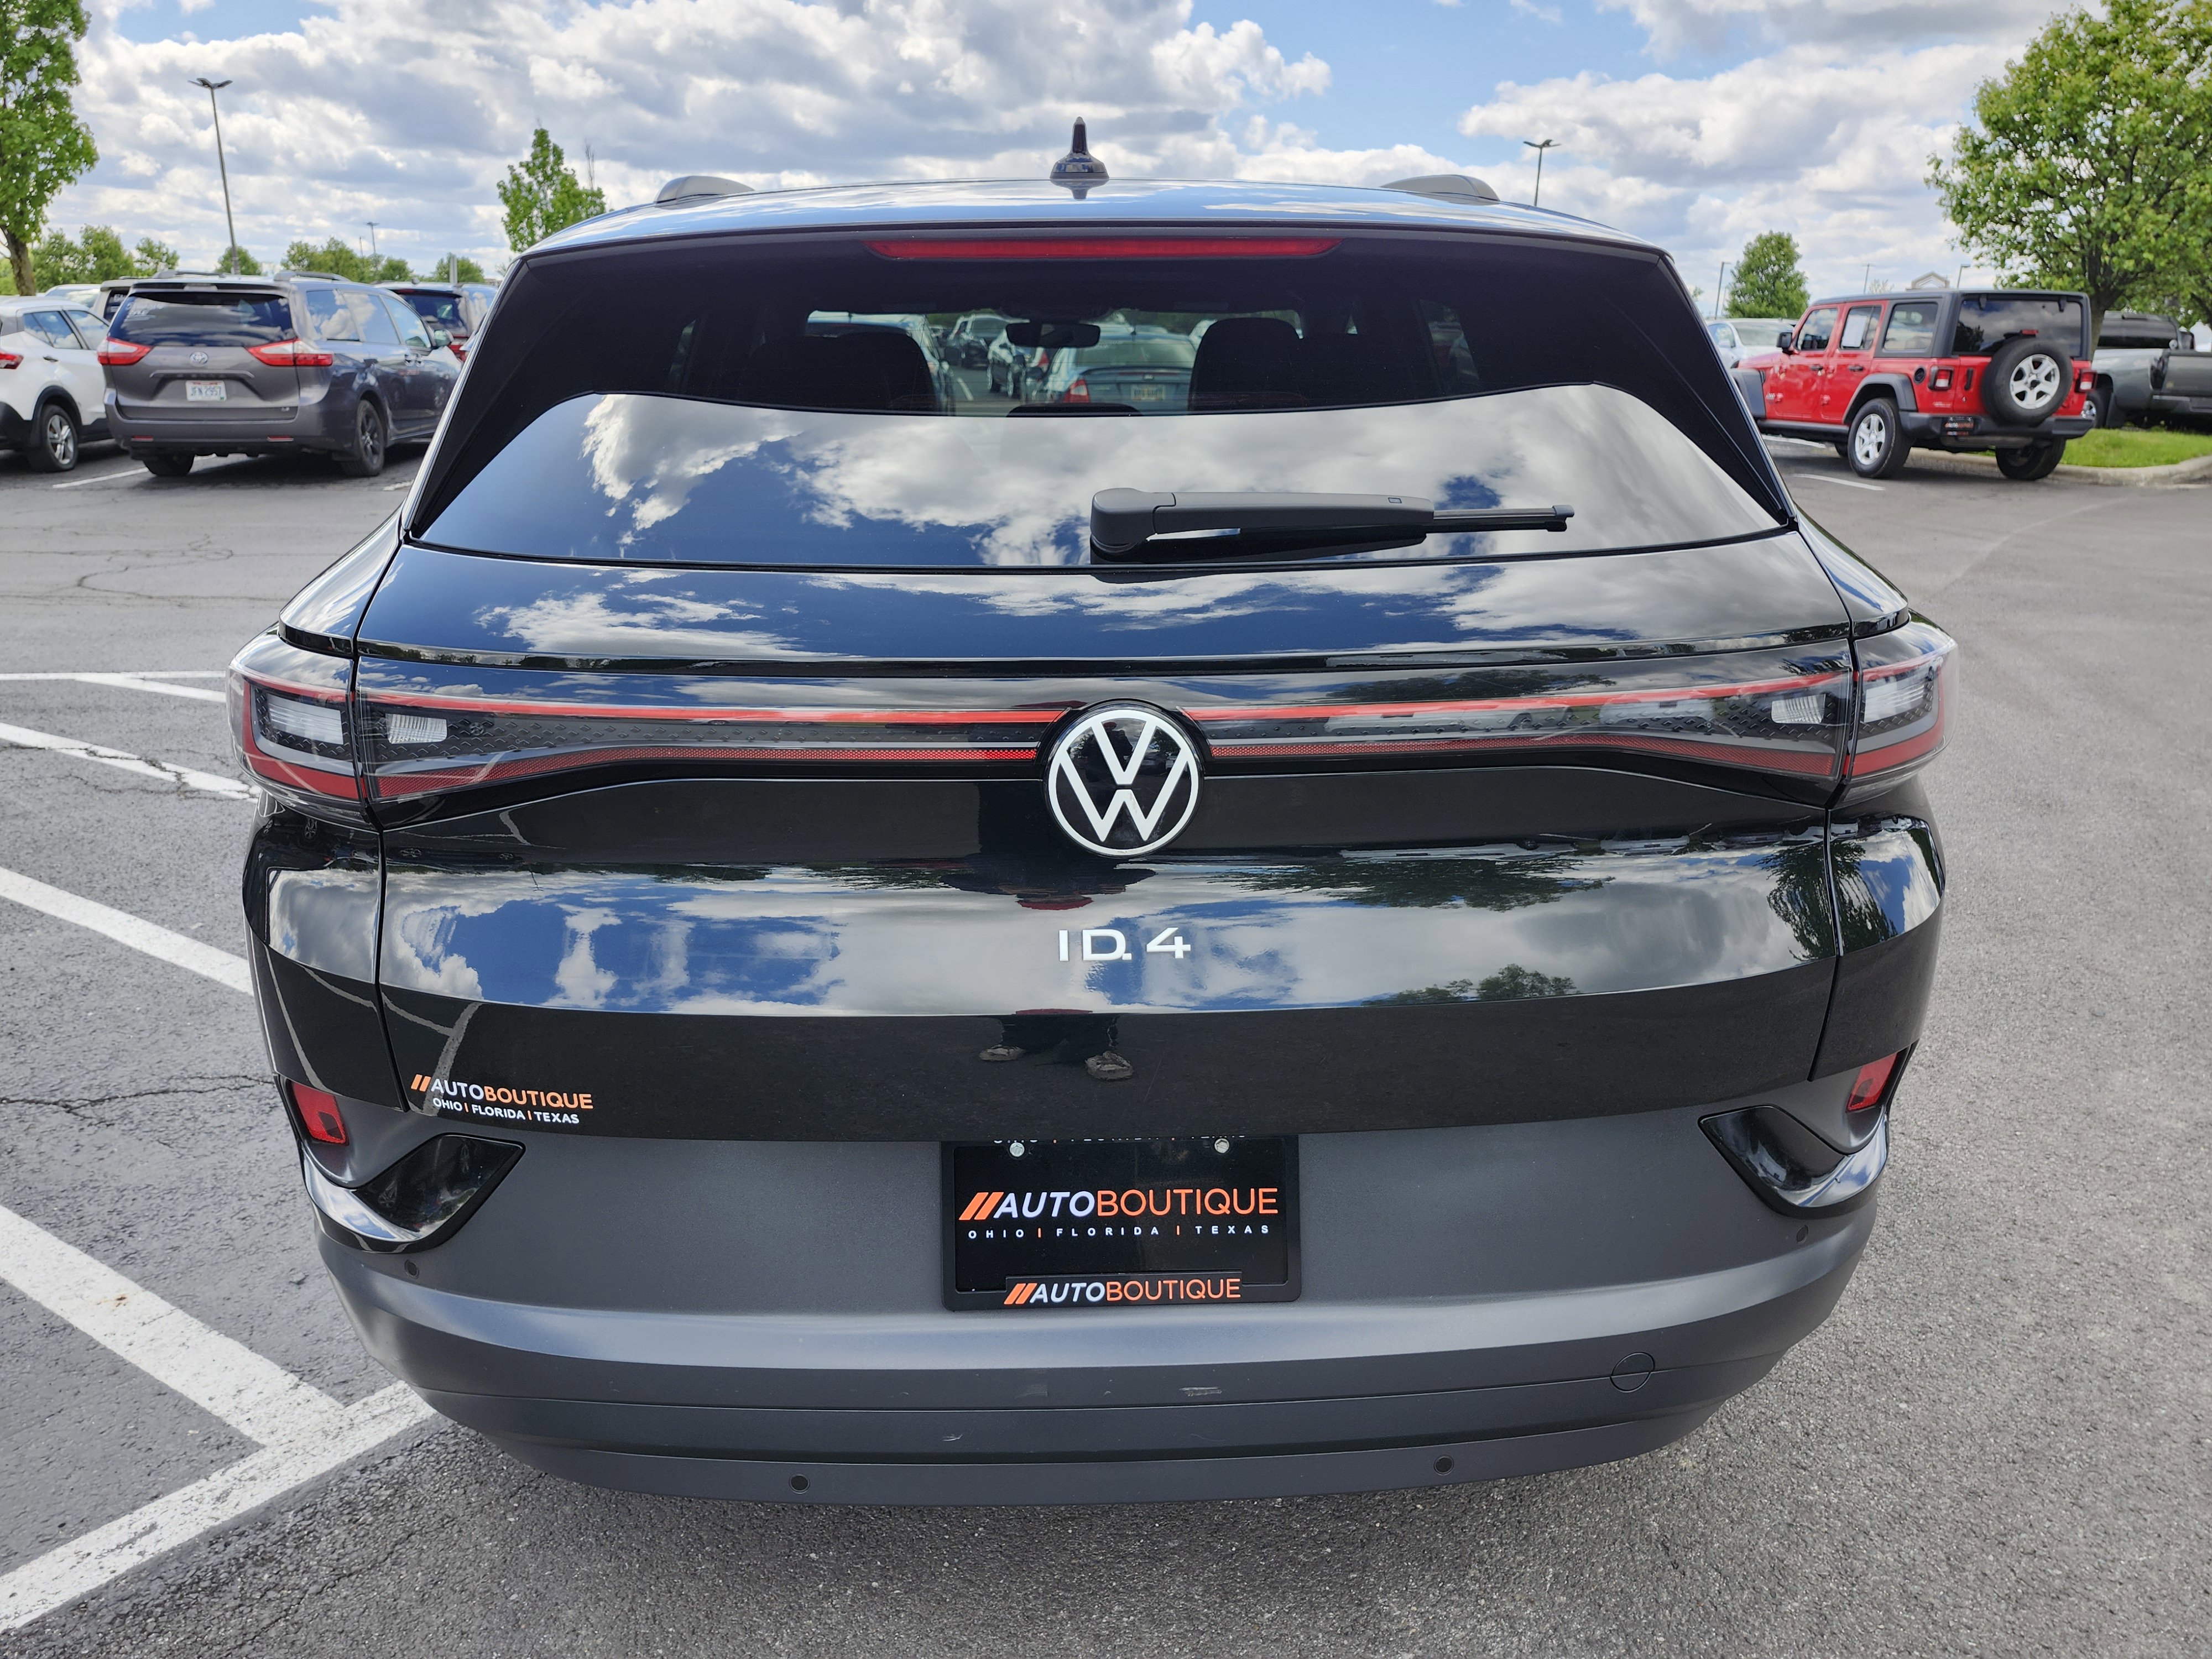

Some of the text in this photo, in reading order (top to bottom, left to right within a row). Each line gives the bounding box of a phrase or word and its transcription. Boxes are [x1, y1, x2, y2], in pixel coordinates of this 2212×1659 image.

[430, 1078, 594, 1109] AUTOBOUTIQUE
[432, 1097, 580, 1125] OHIO FLORIDA TEXAS
[993, 1188, 1279, 1219] AUTOBOUTIQUE
[968, 1225, 1269, 1239] OHIO FLORIDA TEXAS
[1029, 1278, 1241, 1304] AUTOBOUTIQUE
